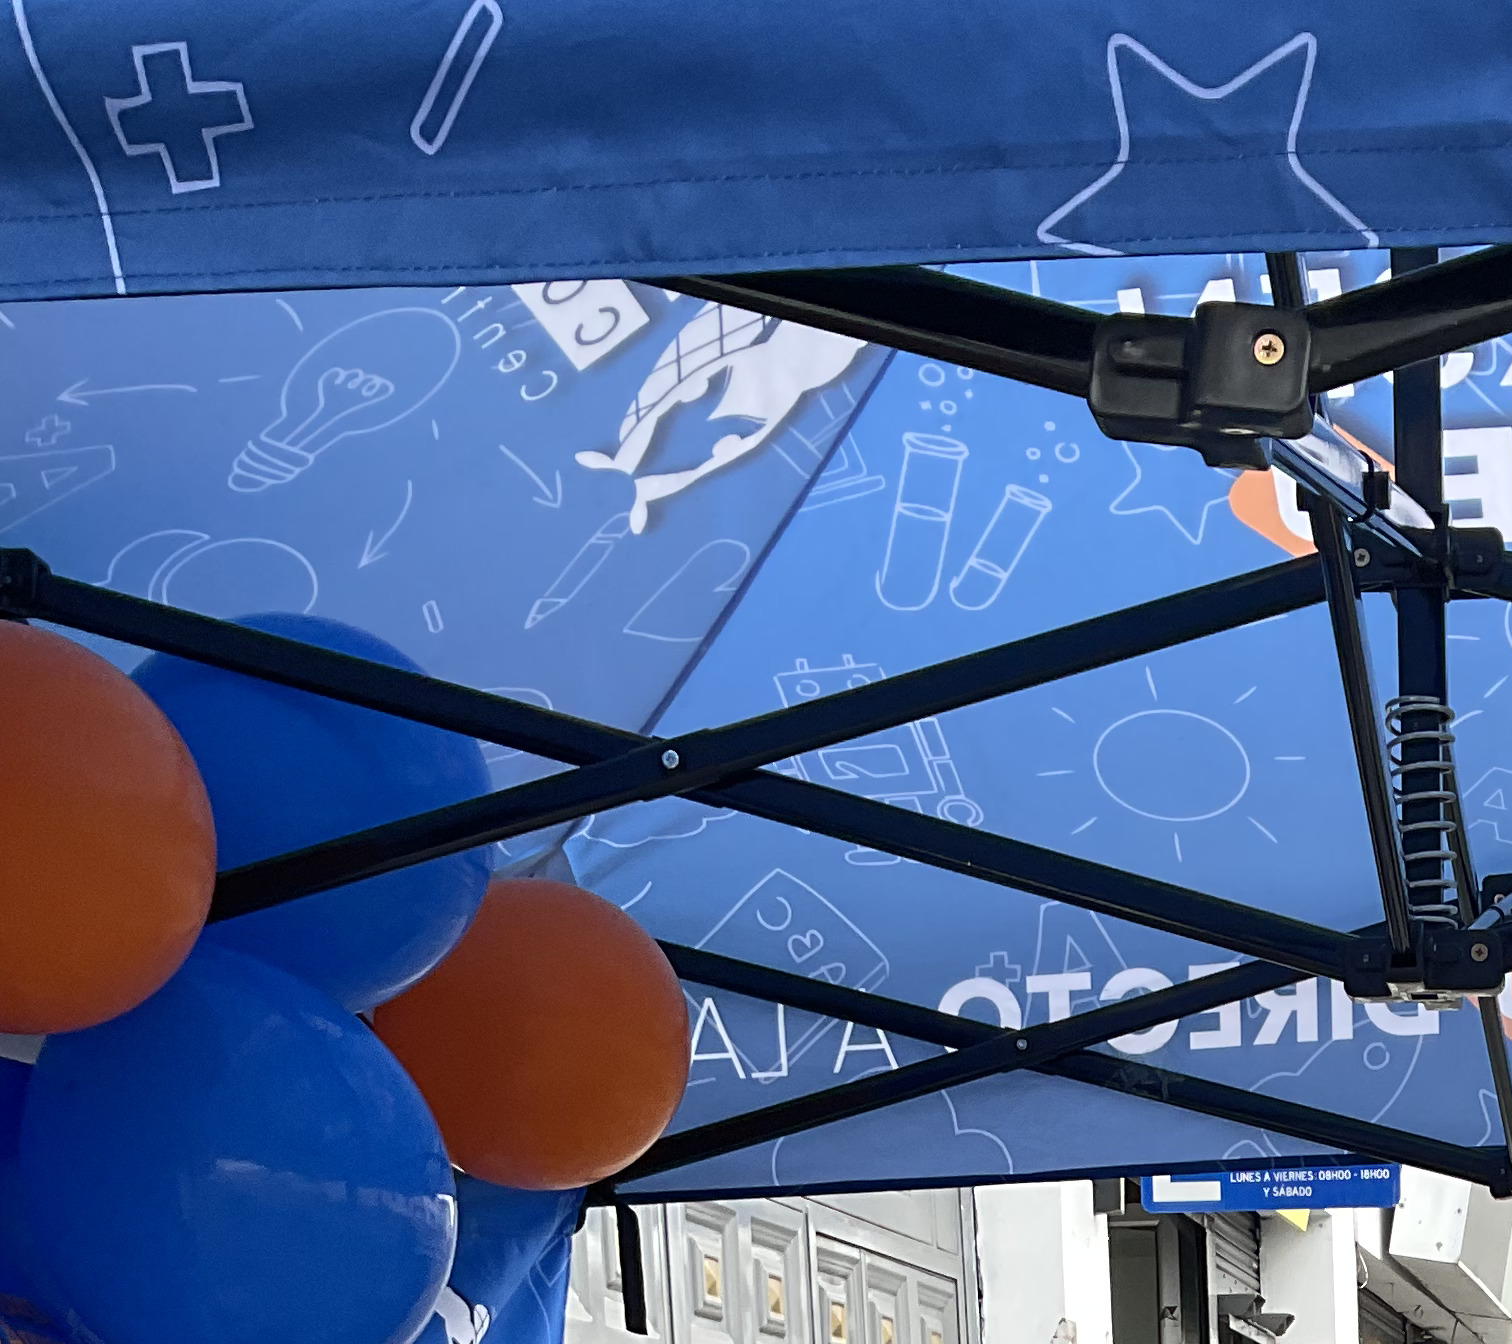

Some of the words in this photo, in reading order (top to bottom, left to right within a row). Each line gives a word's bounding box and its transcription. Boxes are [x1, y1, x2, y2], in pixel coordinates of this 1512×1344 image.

[1230, 1170, 1261, 1183] LUNES
[1263, 1170, 1271, 1182] A
[1263, 1187, 1270, 1198] Y
